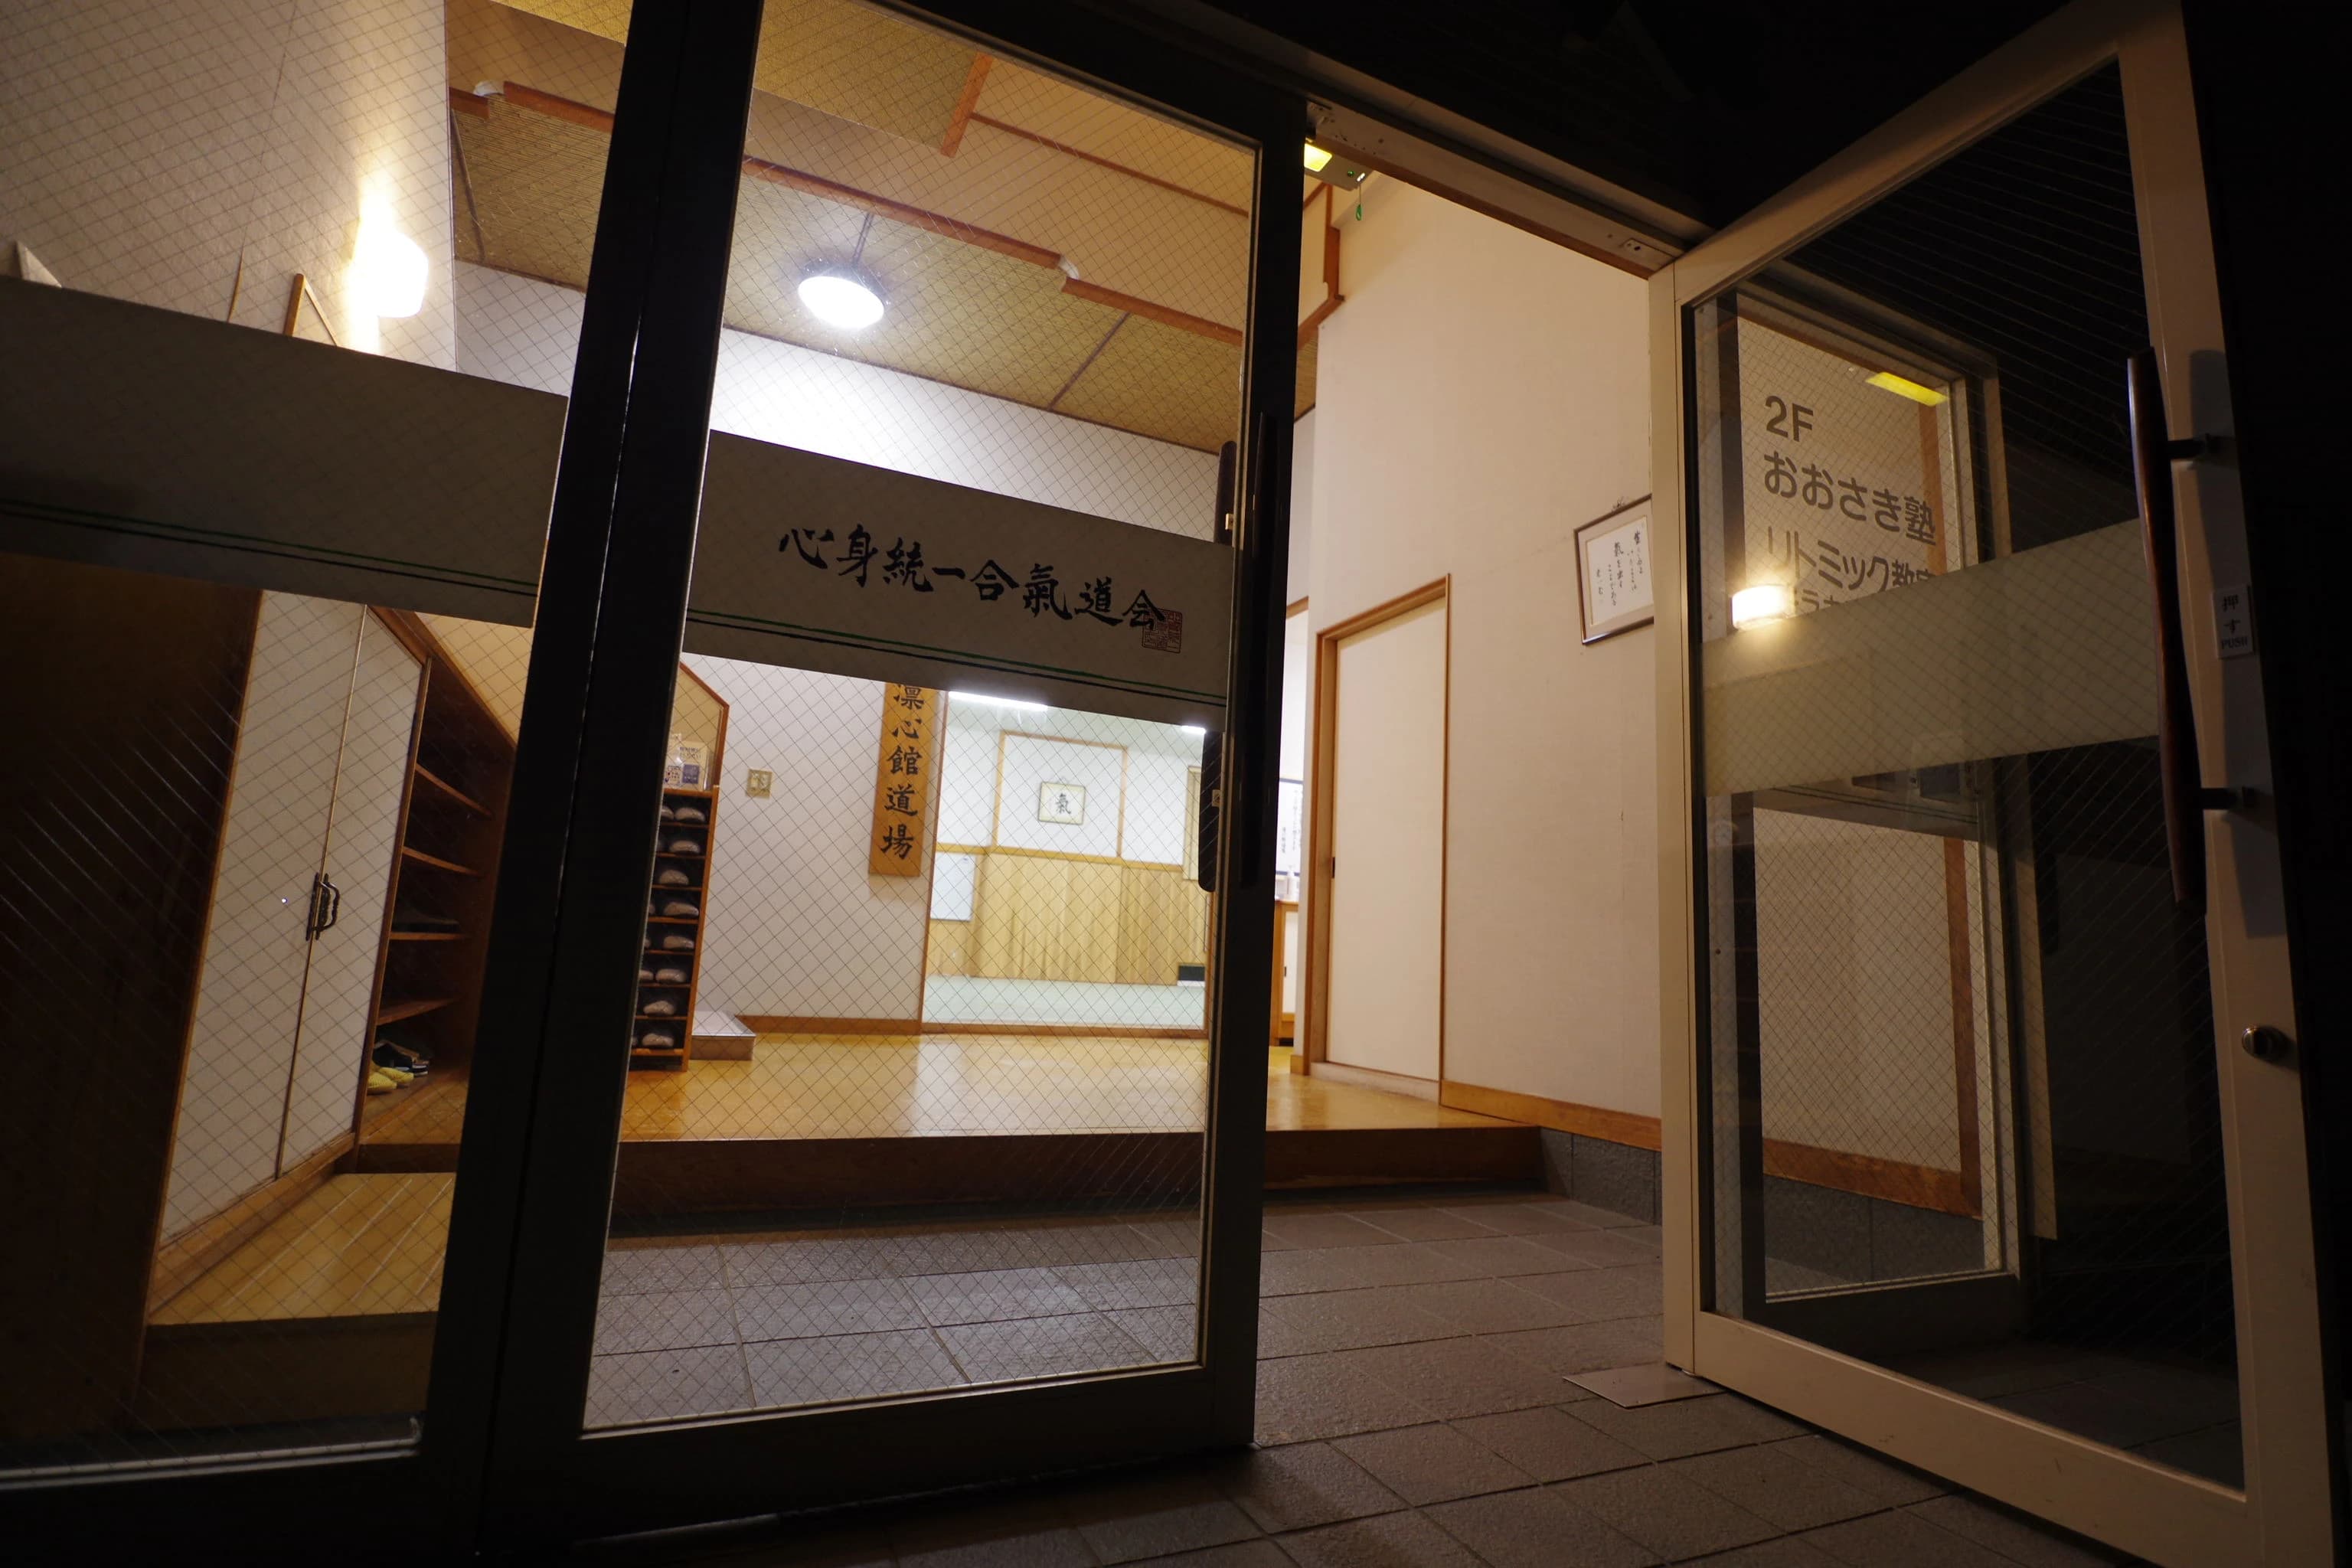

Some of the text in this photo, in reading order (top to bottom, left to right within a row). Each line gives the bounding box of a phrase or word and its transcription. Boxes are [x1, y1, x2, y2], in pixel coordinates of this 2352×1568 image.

[1765, 396, 1814, 442] 2F
[1764, 450, 1936, 545] おおさき塾
[779, 524, 1165, 629] 心身統一合氣道会
[2222, 636, 2248, 649] PUSH
